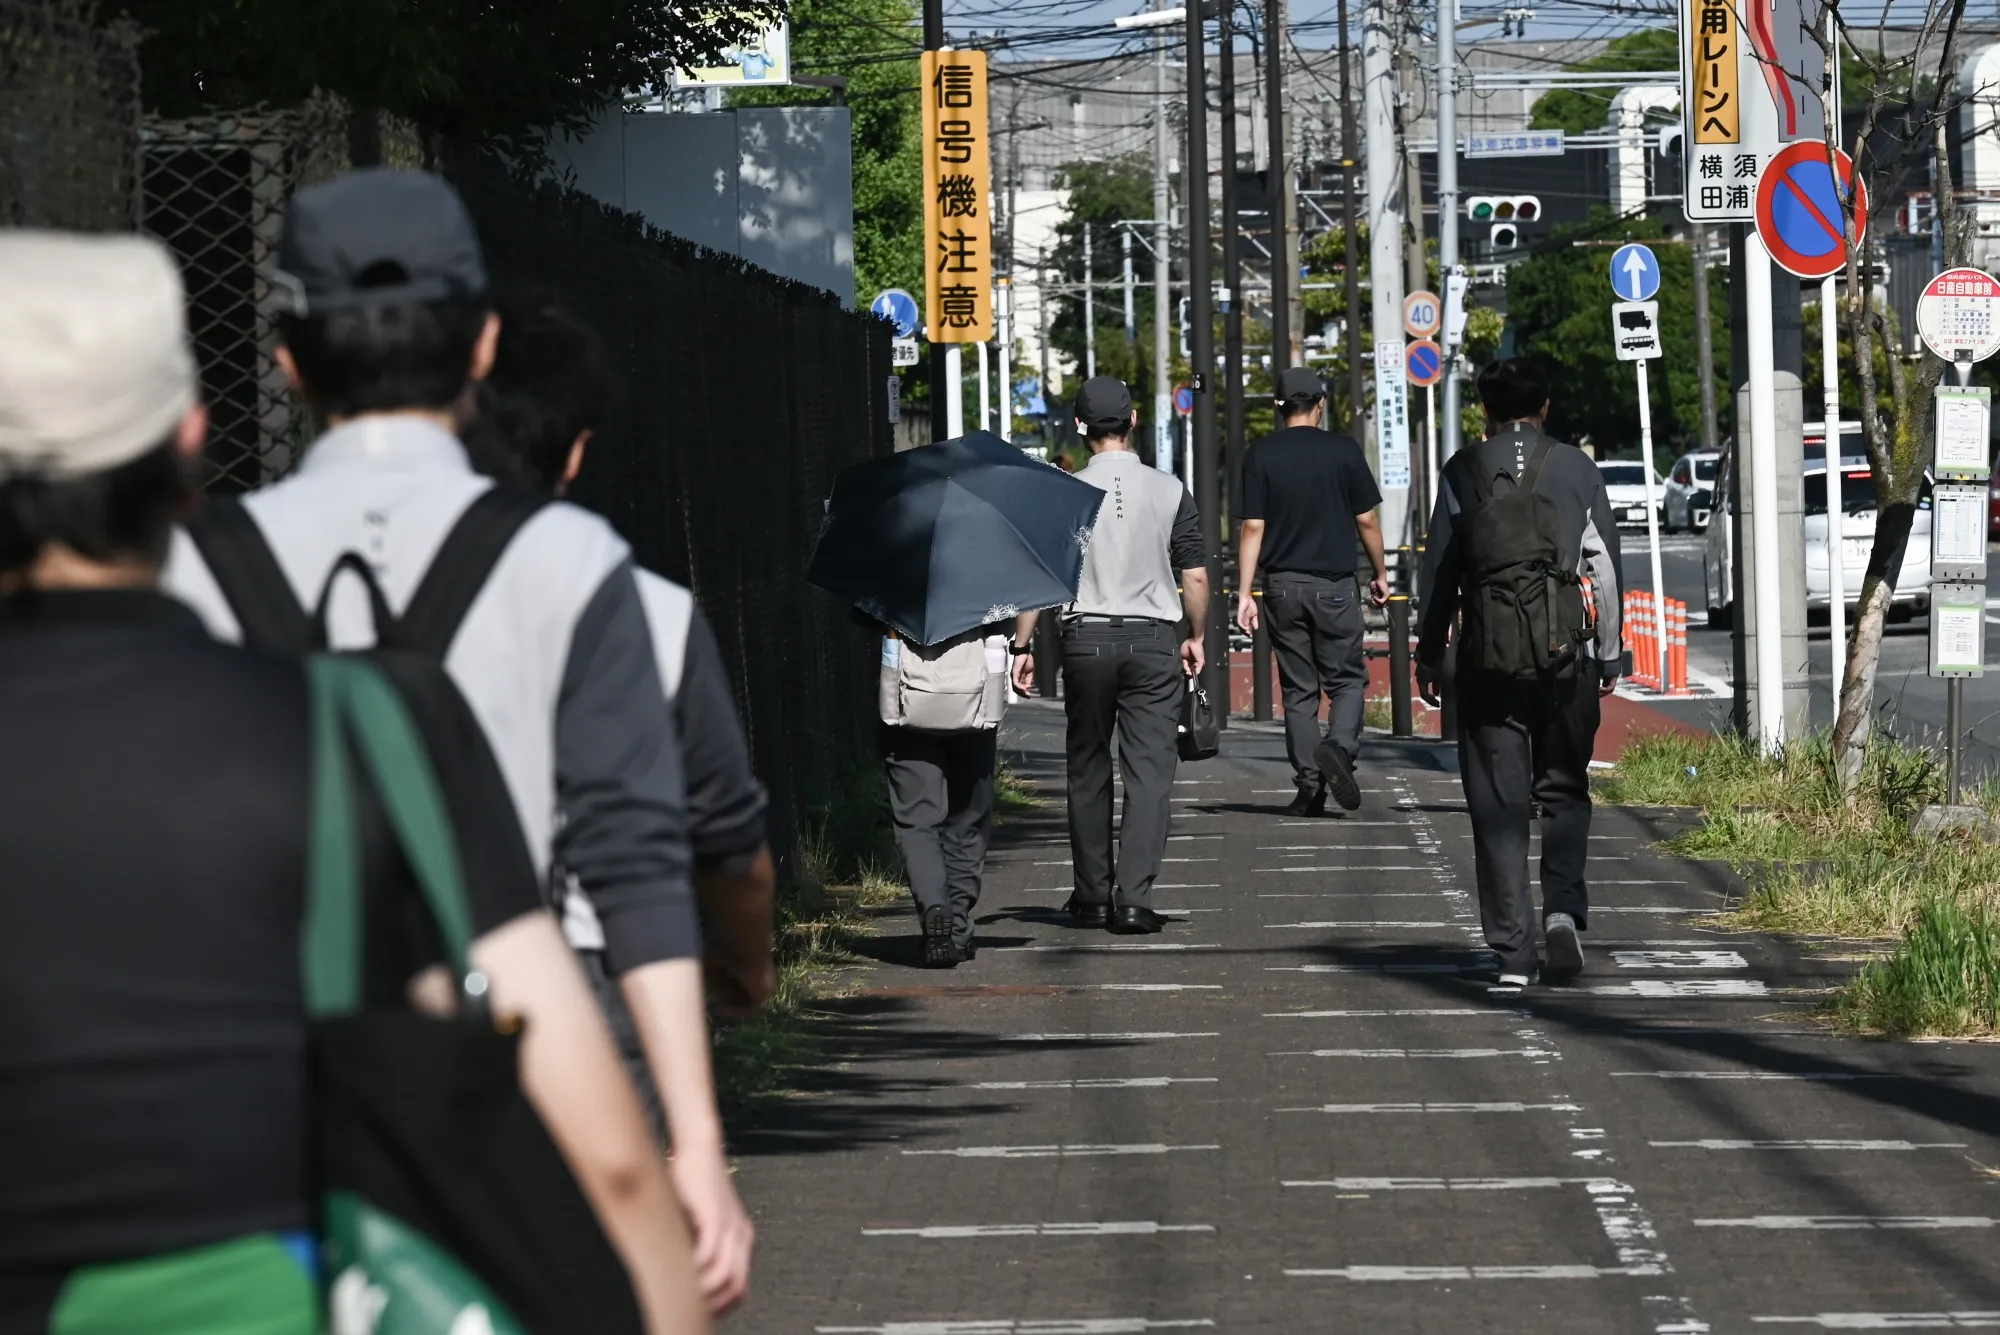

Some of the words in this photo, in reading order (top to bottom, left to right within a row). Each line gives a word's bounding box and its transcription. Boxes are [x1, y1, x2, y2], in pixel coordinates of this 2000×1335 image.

[1700, 0, 1732, 138] 用レーンへ
[1699, 154, 1771, 179] 横須
[932, 64, 979, 328] 信号機注意
[1701, 184, 1756, 209] 田浦
[1937, 281, 1992, 295] 日産自動車前
[1411, 304, 1434, 325] 40
[1114, 476, 1123, 519] NISSAN
